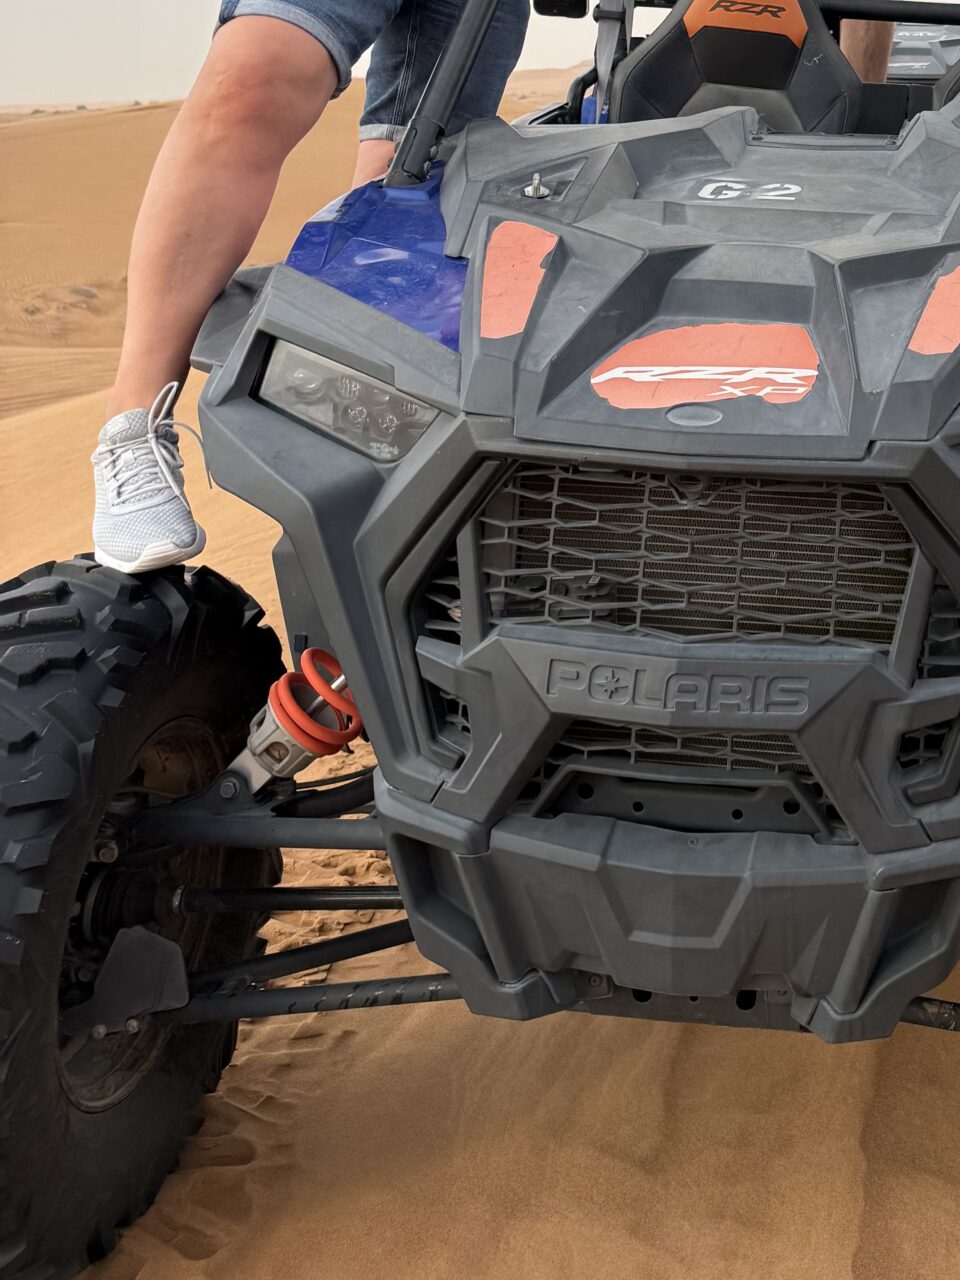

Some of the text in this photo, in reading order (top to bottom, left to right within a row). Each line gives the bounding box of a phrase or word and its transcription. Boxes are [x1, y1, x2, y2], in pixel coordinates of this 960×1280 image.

[707, 0, 786, 19] RZR
[590, 366, 819, 385] RZR
[707, 385, 810, 397] XP
[546, 658, 810, 716] POLARIS
